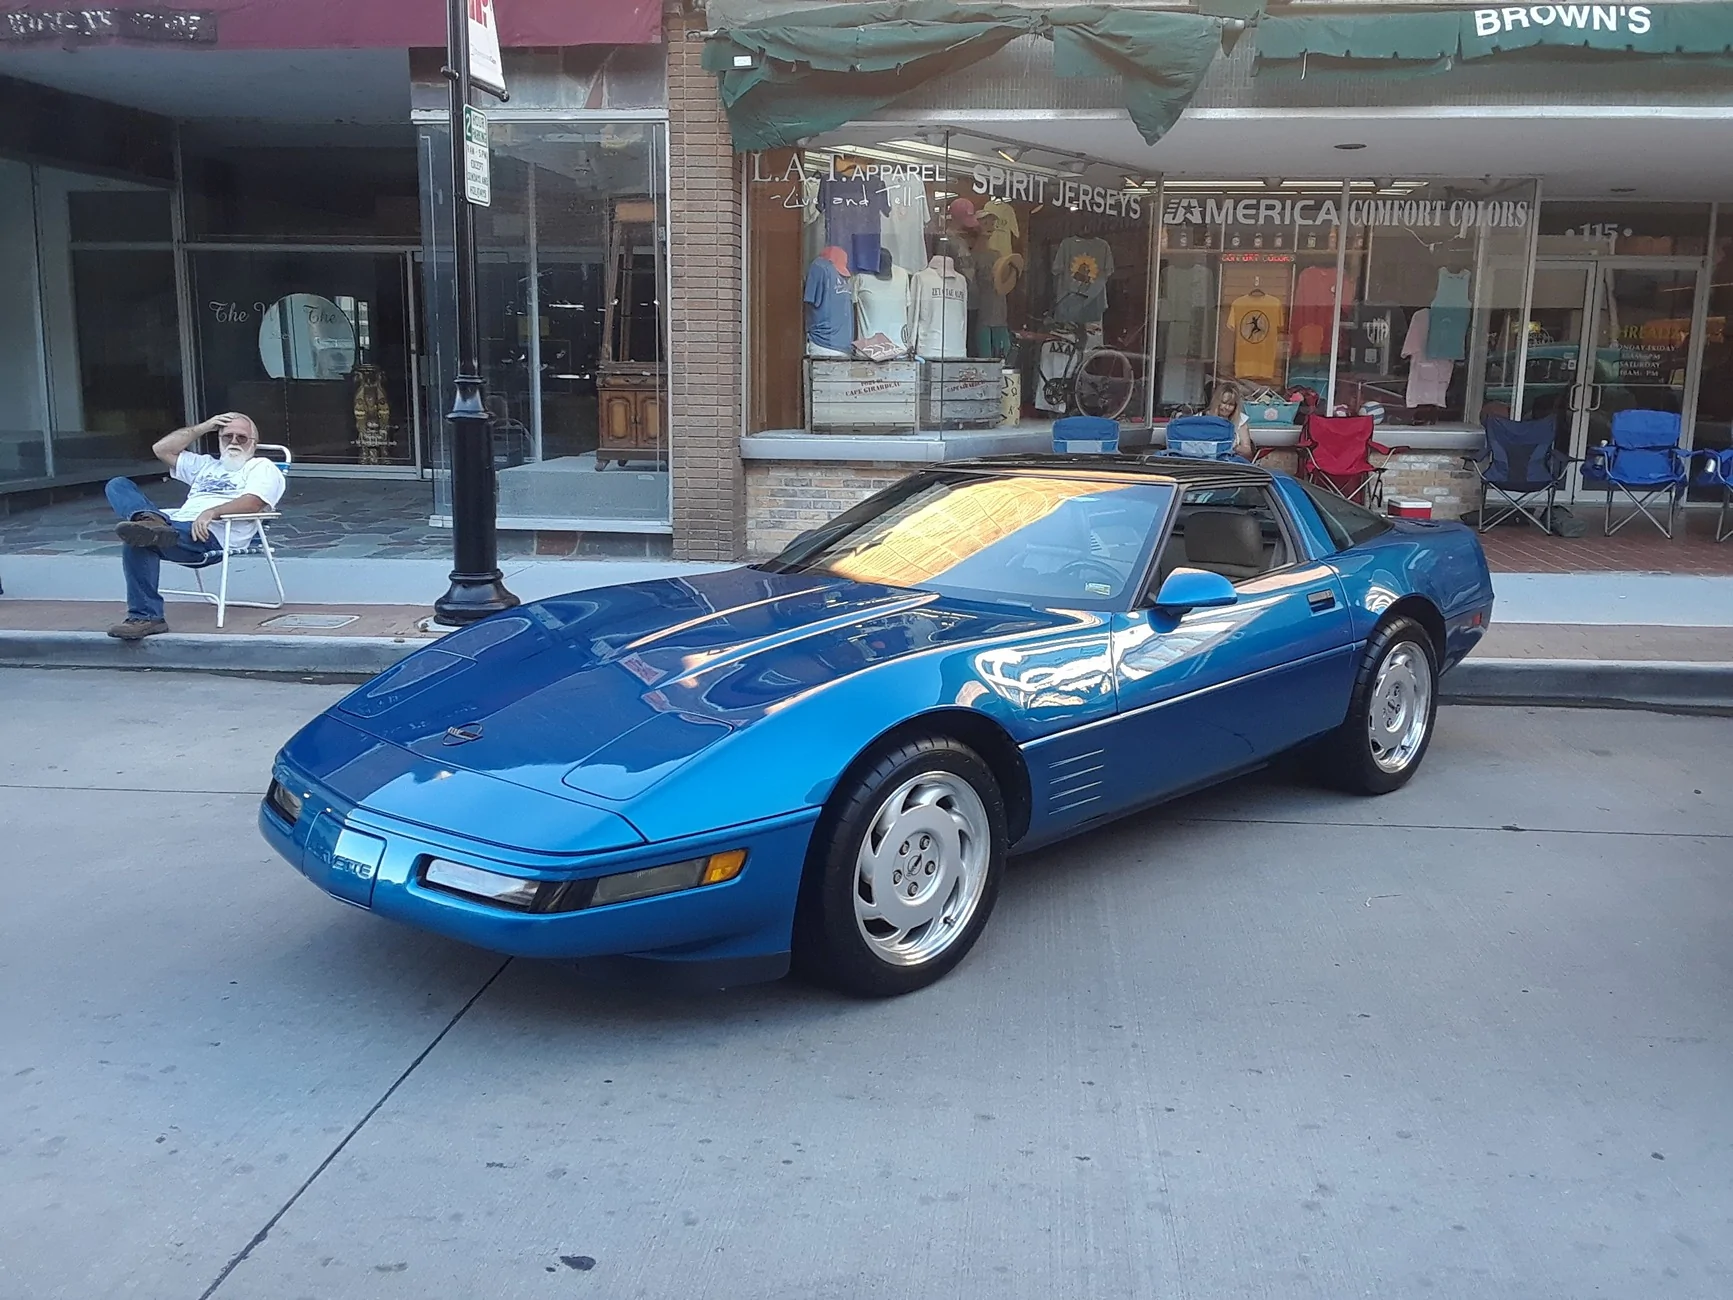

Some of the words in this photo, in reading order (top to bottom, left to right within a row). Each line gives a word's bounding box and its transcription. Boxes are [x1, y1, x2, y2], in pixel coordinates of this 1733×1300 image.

[1474, 5, 1651, 36] BROWN'S
[465, 113, 472, 137] 2
[851, 164, 946, 182] APPAREL
[832, 184, 869, 207] and
[972, 164, 1049, 203] SPIRIT
[1052, 179, 1142, 219] JERSEYS
[1350, 199, 1446, 226] COMFORT
[1450, 199, 1529, 227] COLORS
[1579, 223, 1619, 243] 115
[209, 301, 250, 323] The
[1620, 360, 1661, 369] SATURDAY
